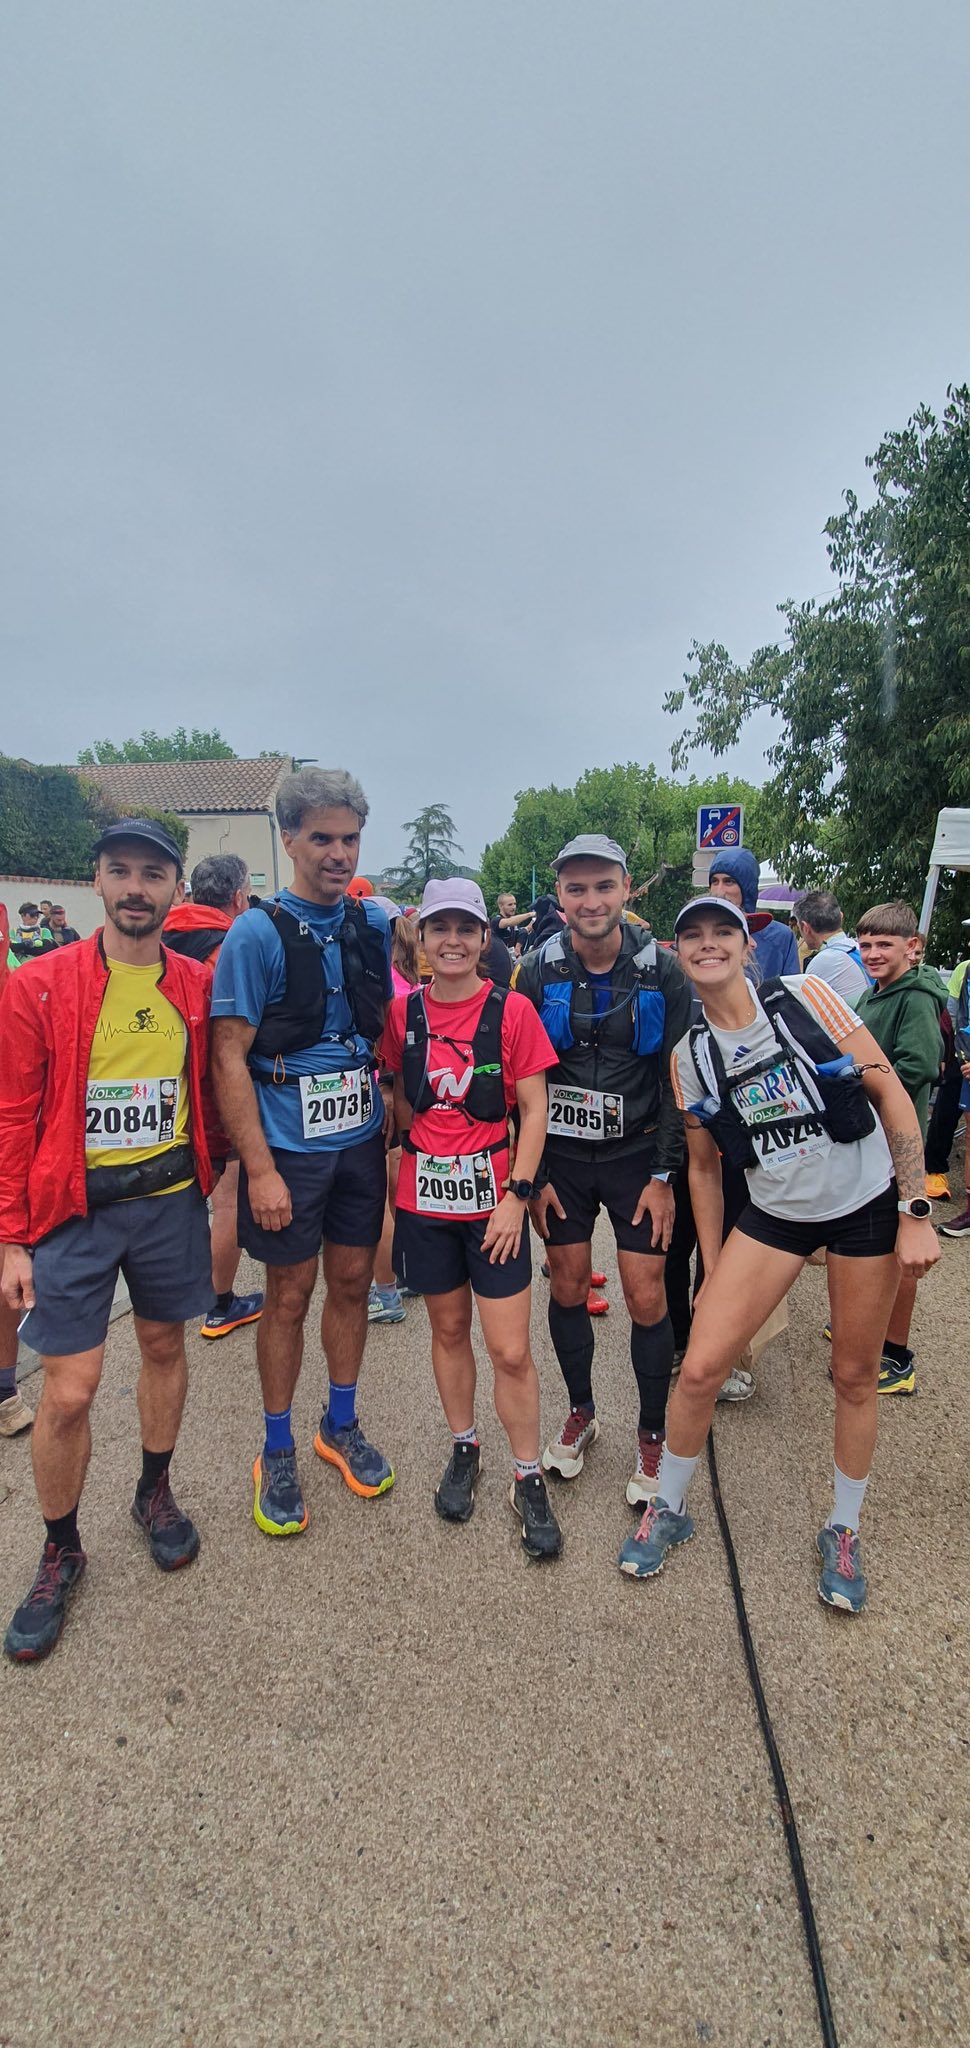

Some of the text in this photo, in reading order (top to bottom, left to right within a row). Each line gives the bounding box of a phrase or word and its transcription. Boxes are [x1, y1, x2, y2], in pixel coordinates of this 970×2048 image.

[725, 832, 735, 840] 20
[87, 1084, 120, 1099] VOLX
[307, 1093, 358, 1125] 2073
[362, 1102, 371, 1113] 13
[86, 1104, 158, 1134] 2084
[550, 1102, 601, 1131] 2085
[161, 1119, 172, 1131] 13
[418, 1175, 474, 1202] 2096
[479, 1188, 492, 1201] 13
